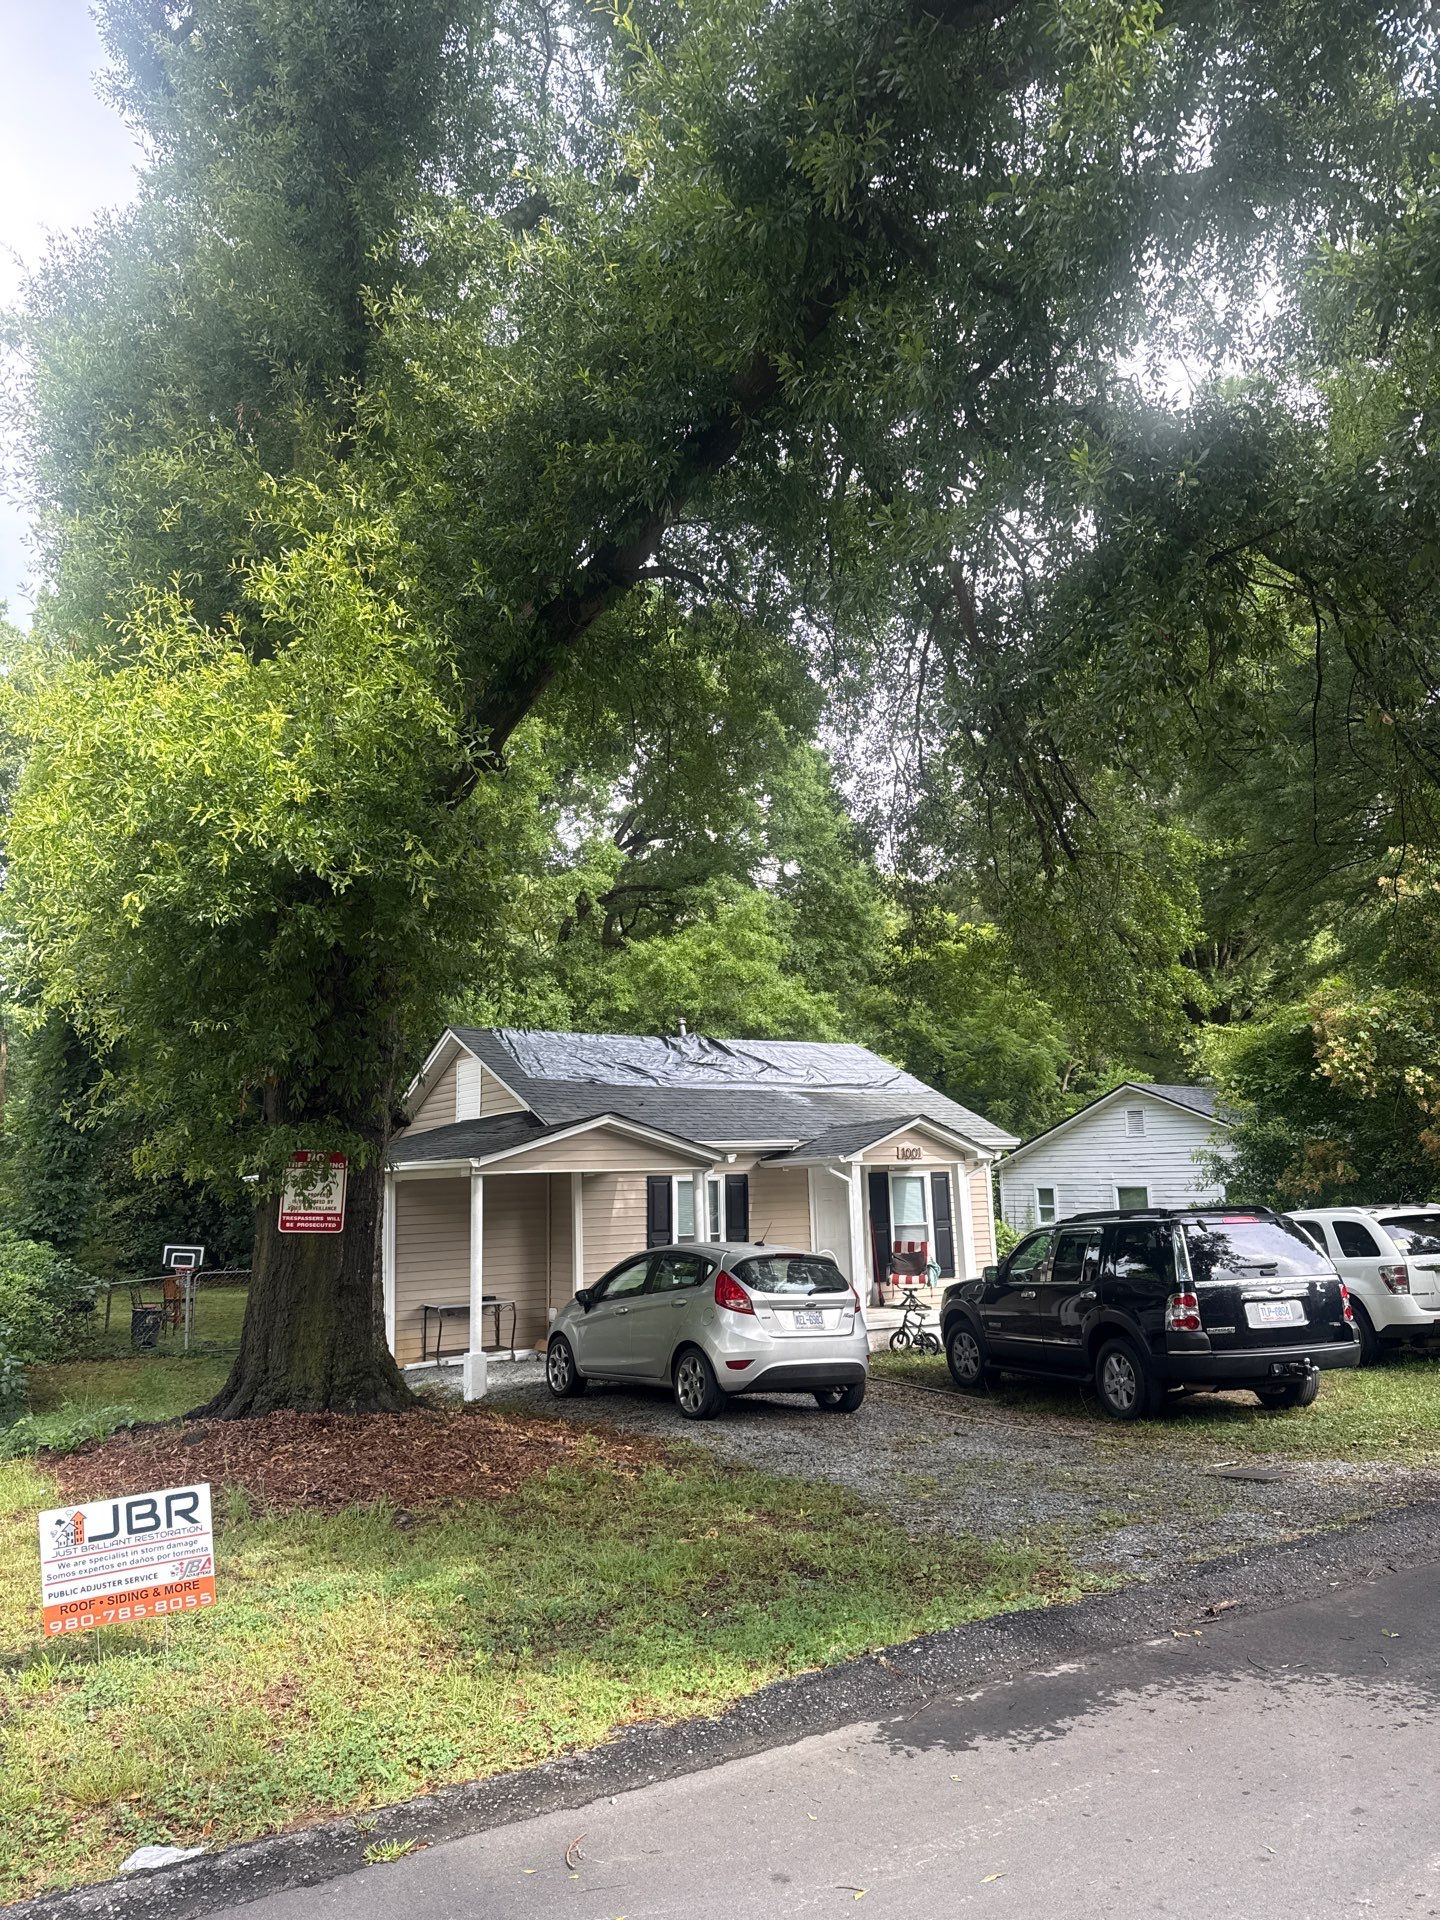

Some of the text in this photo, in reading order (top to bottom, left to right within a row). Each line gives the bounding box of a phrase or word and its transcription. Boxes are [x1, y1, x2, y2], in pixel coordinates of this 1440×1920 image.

[88, 1490, 201, 1542] JBR
[51, 1525, 203, 1559] JUST BRILLIANT RESTORATION
[57, 1562, 71, 1570] We
[73, 1560, 87, 1568] are
[89, 1550, 129, 1565] specialist
[141, 1545, 164, 1554] storm
[166, 1539, 198, 1550] damage
[46, 1546, 209, 1582] Somos expertos en daños por tormenta
[48, 1572, 158, 1599] PUBLIC ADJUSTER SERVICE
[60, 1579, 200, 1616] ROOF SIDING & MORE
[49, 1592, 213, 1634] 980-785-8055
